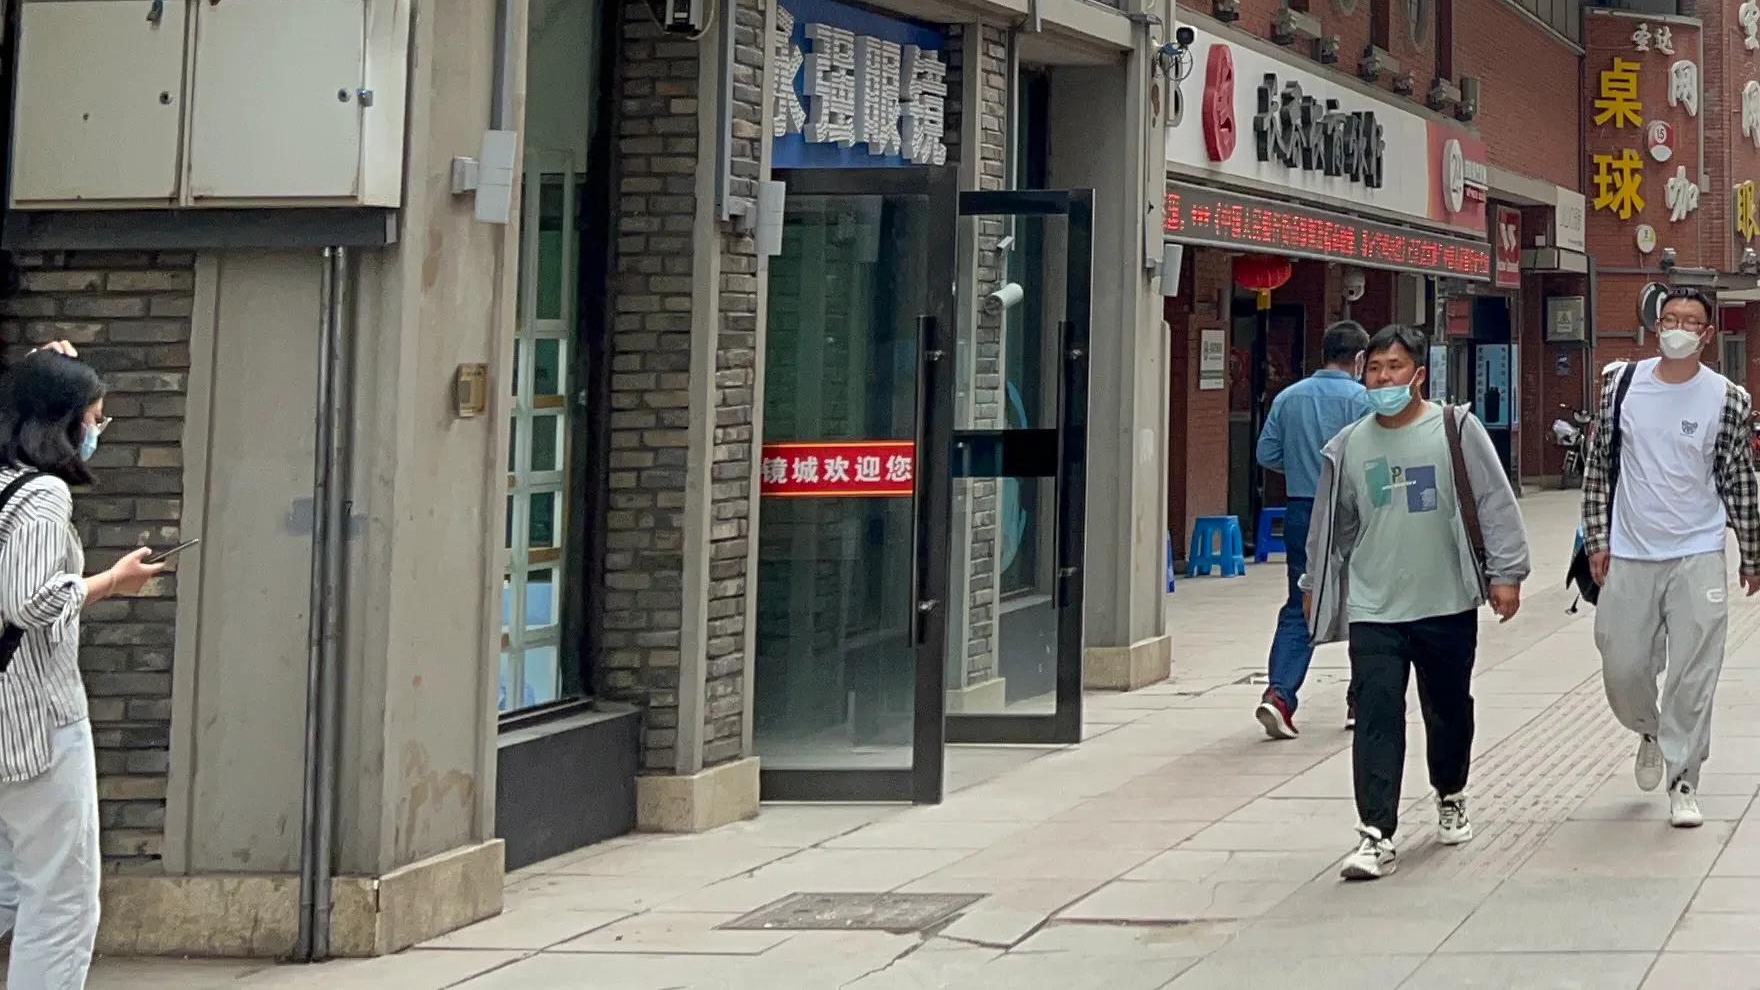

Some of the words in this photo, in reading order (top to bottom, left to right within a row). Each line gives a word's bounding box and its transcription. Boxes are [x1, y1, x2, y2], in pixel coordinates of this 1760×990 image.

[1592, 57, 1645, 220] 桌球
[761, 449, 913, 486] 镜城欢迎您
